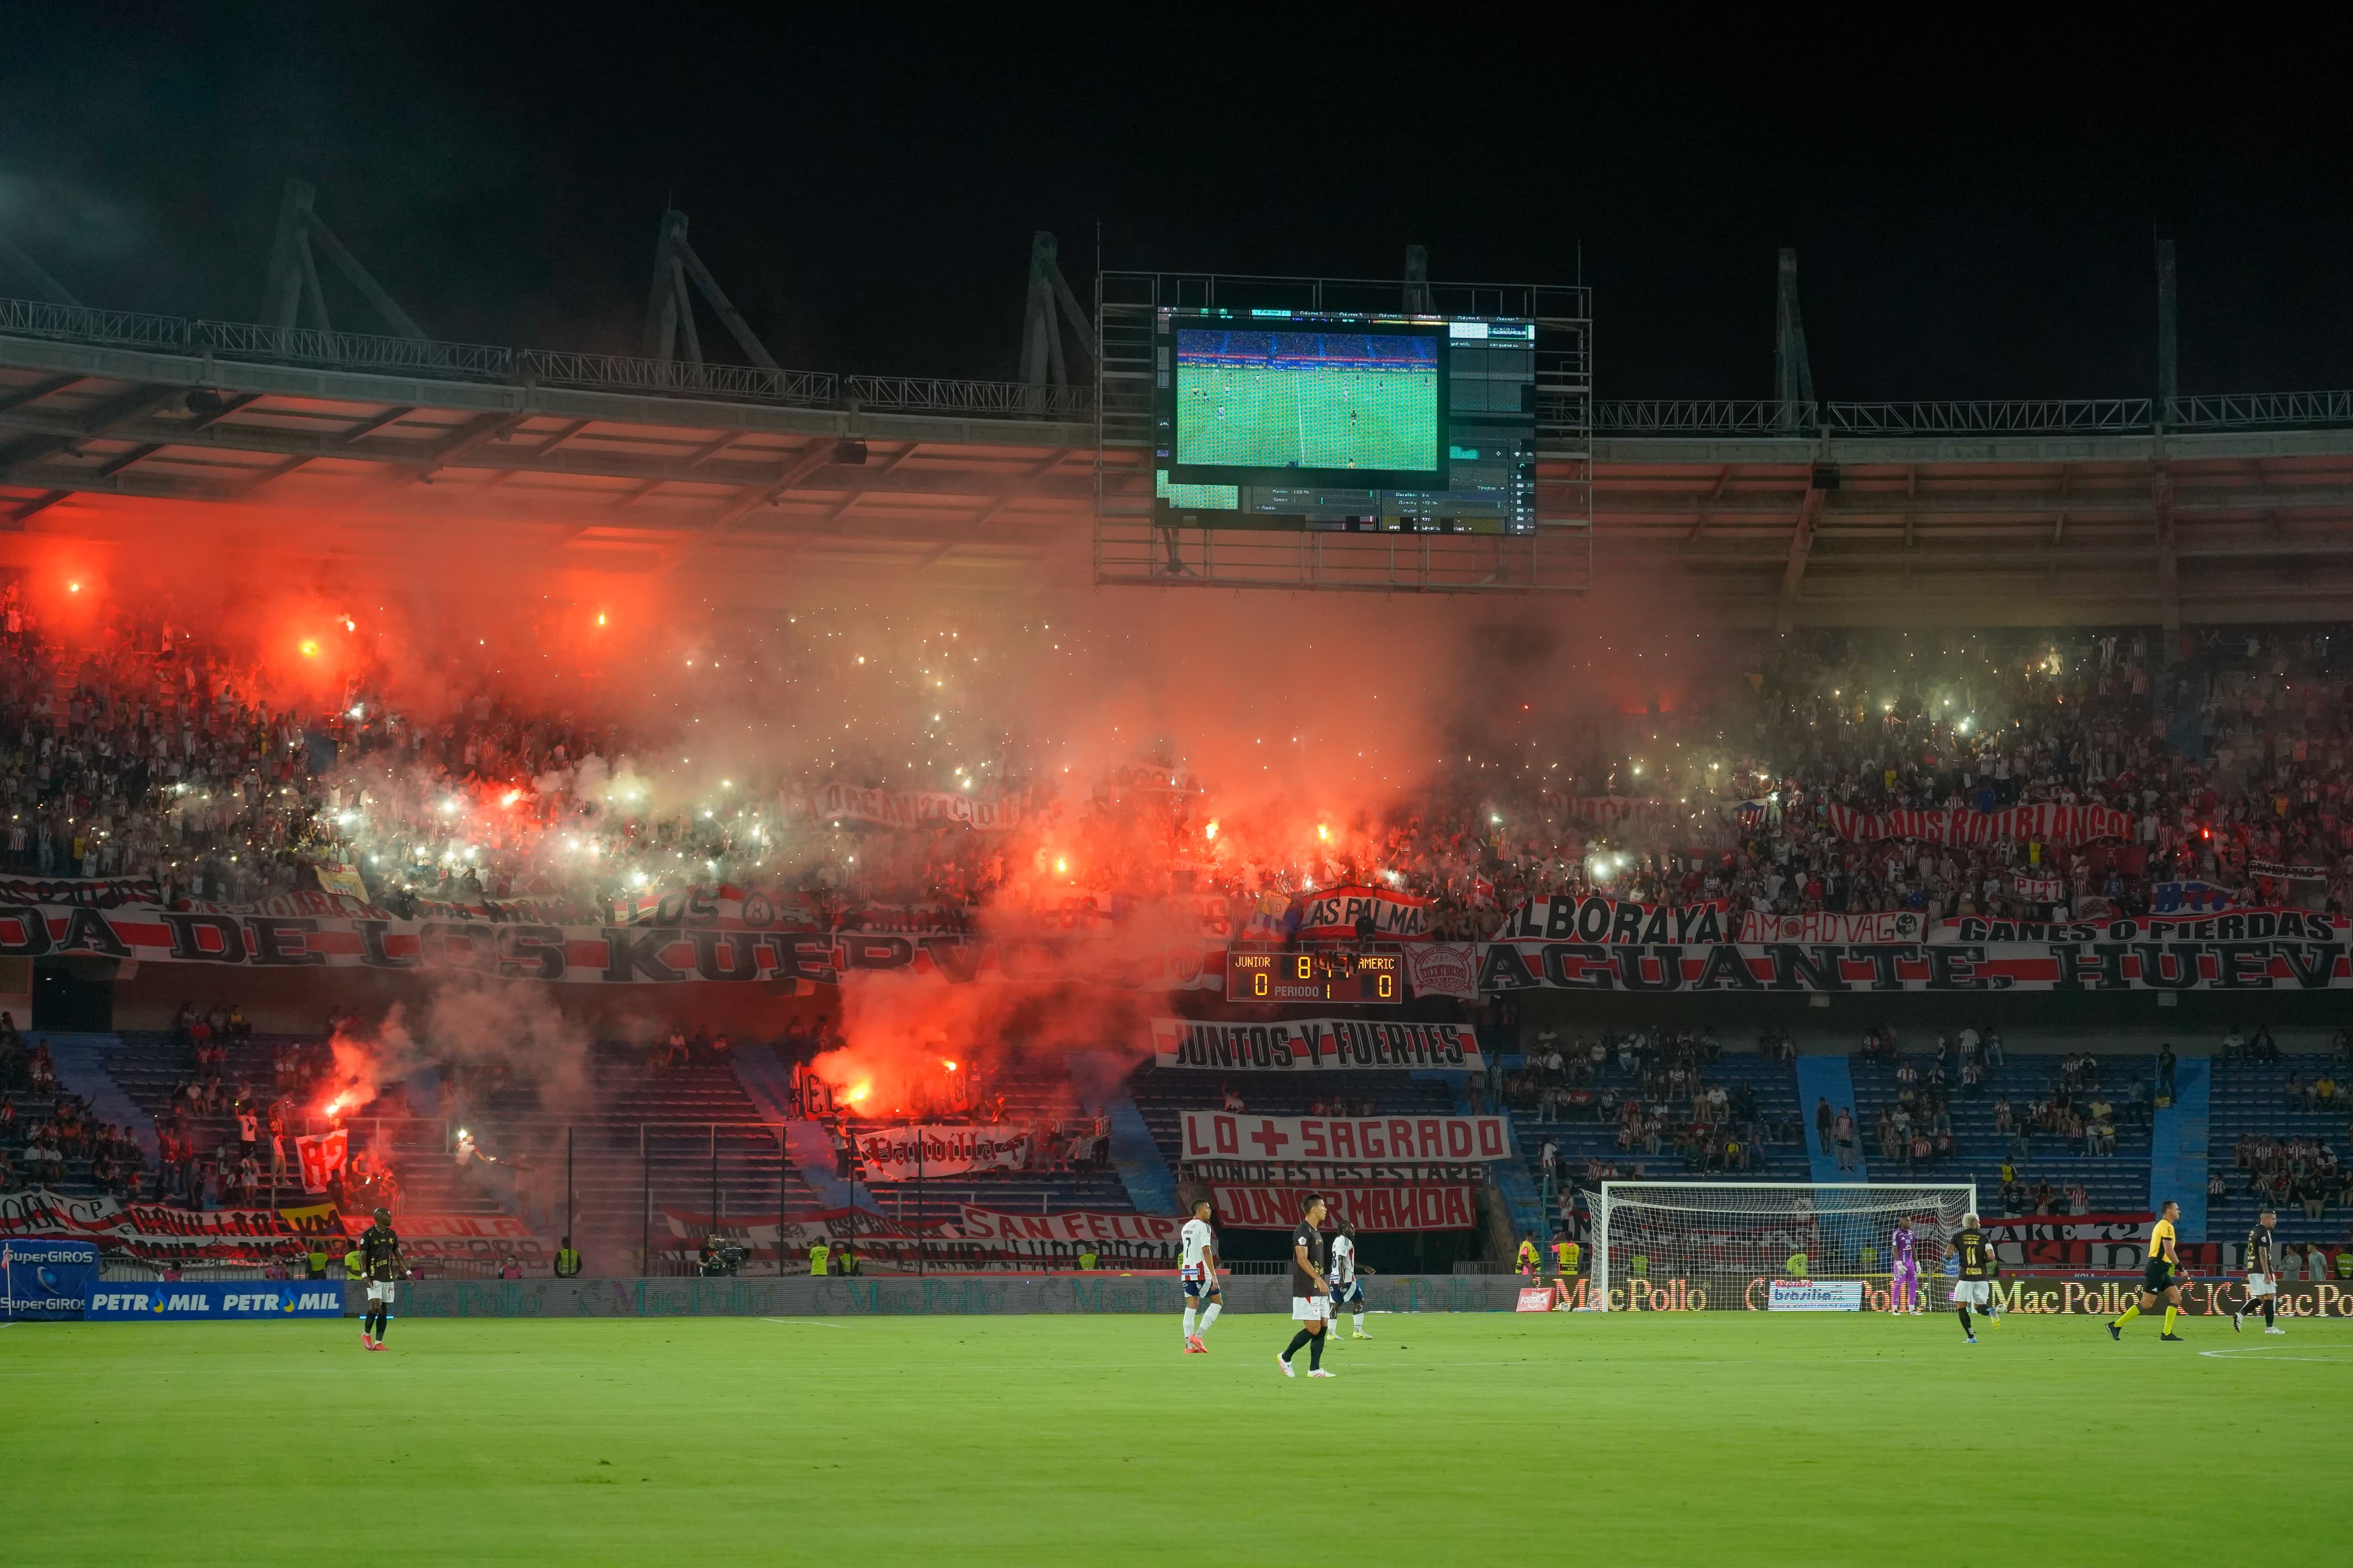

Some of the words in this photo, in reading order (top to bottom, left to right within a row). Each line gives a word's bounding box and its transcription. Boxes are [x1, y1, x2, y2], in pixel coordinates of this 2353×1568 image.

[1958, 917, 2098, 943] GANES
[2108, 920, 2137, 941] O
[2149, 910, 2336, 941] PIERDAS
[160, 914, 327, 966] DE
[353, 921, 566, 980] LOS
[2051, 941, 2353, 990] HUEV
[1235, 956, 1271, 967] JUNIOR
[1358, 958, 1395, 970] AMERIC
[1255, 973, 1268, 996] 0
[1275, 986, 1319, 997] PERIODO
[1326, 984, 1330, 1000] 1
[1379, 975, 1391, 997] 0
[1175, 1023, 1294, 1067] JUNTOS
[1299, 1024, 1321, 1066] Y
[1332, 1021, 1466, 1065] FUERTES
[1187, 1115, 1240, 1156] LO
[1300, 1119, 1504, 1159] SAGRADO
[965, 1209, 1051, 1239] SAN
[2093, 1221, 2143, 1241] 72
[3, 1250, 93, 1264] SuperGIROS
[1186, 1237, 1191, 1258] 7
[1966, 1246, 1977, 1266] 11
[1520, 1295, 1548, 1304] POSTOBON
